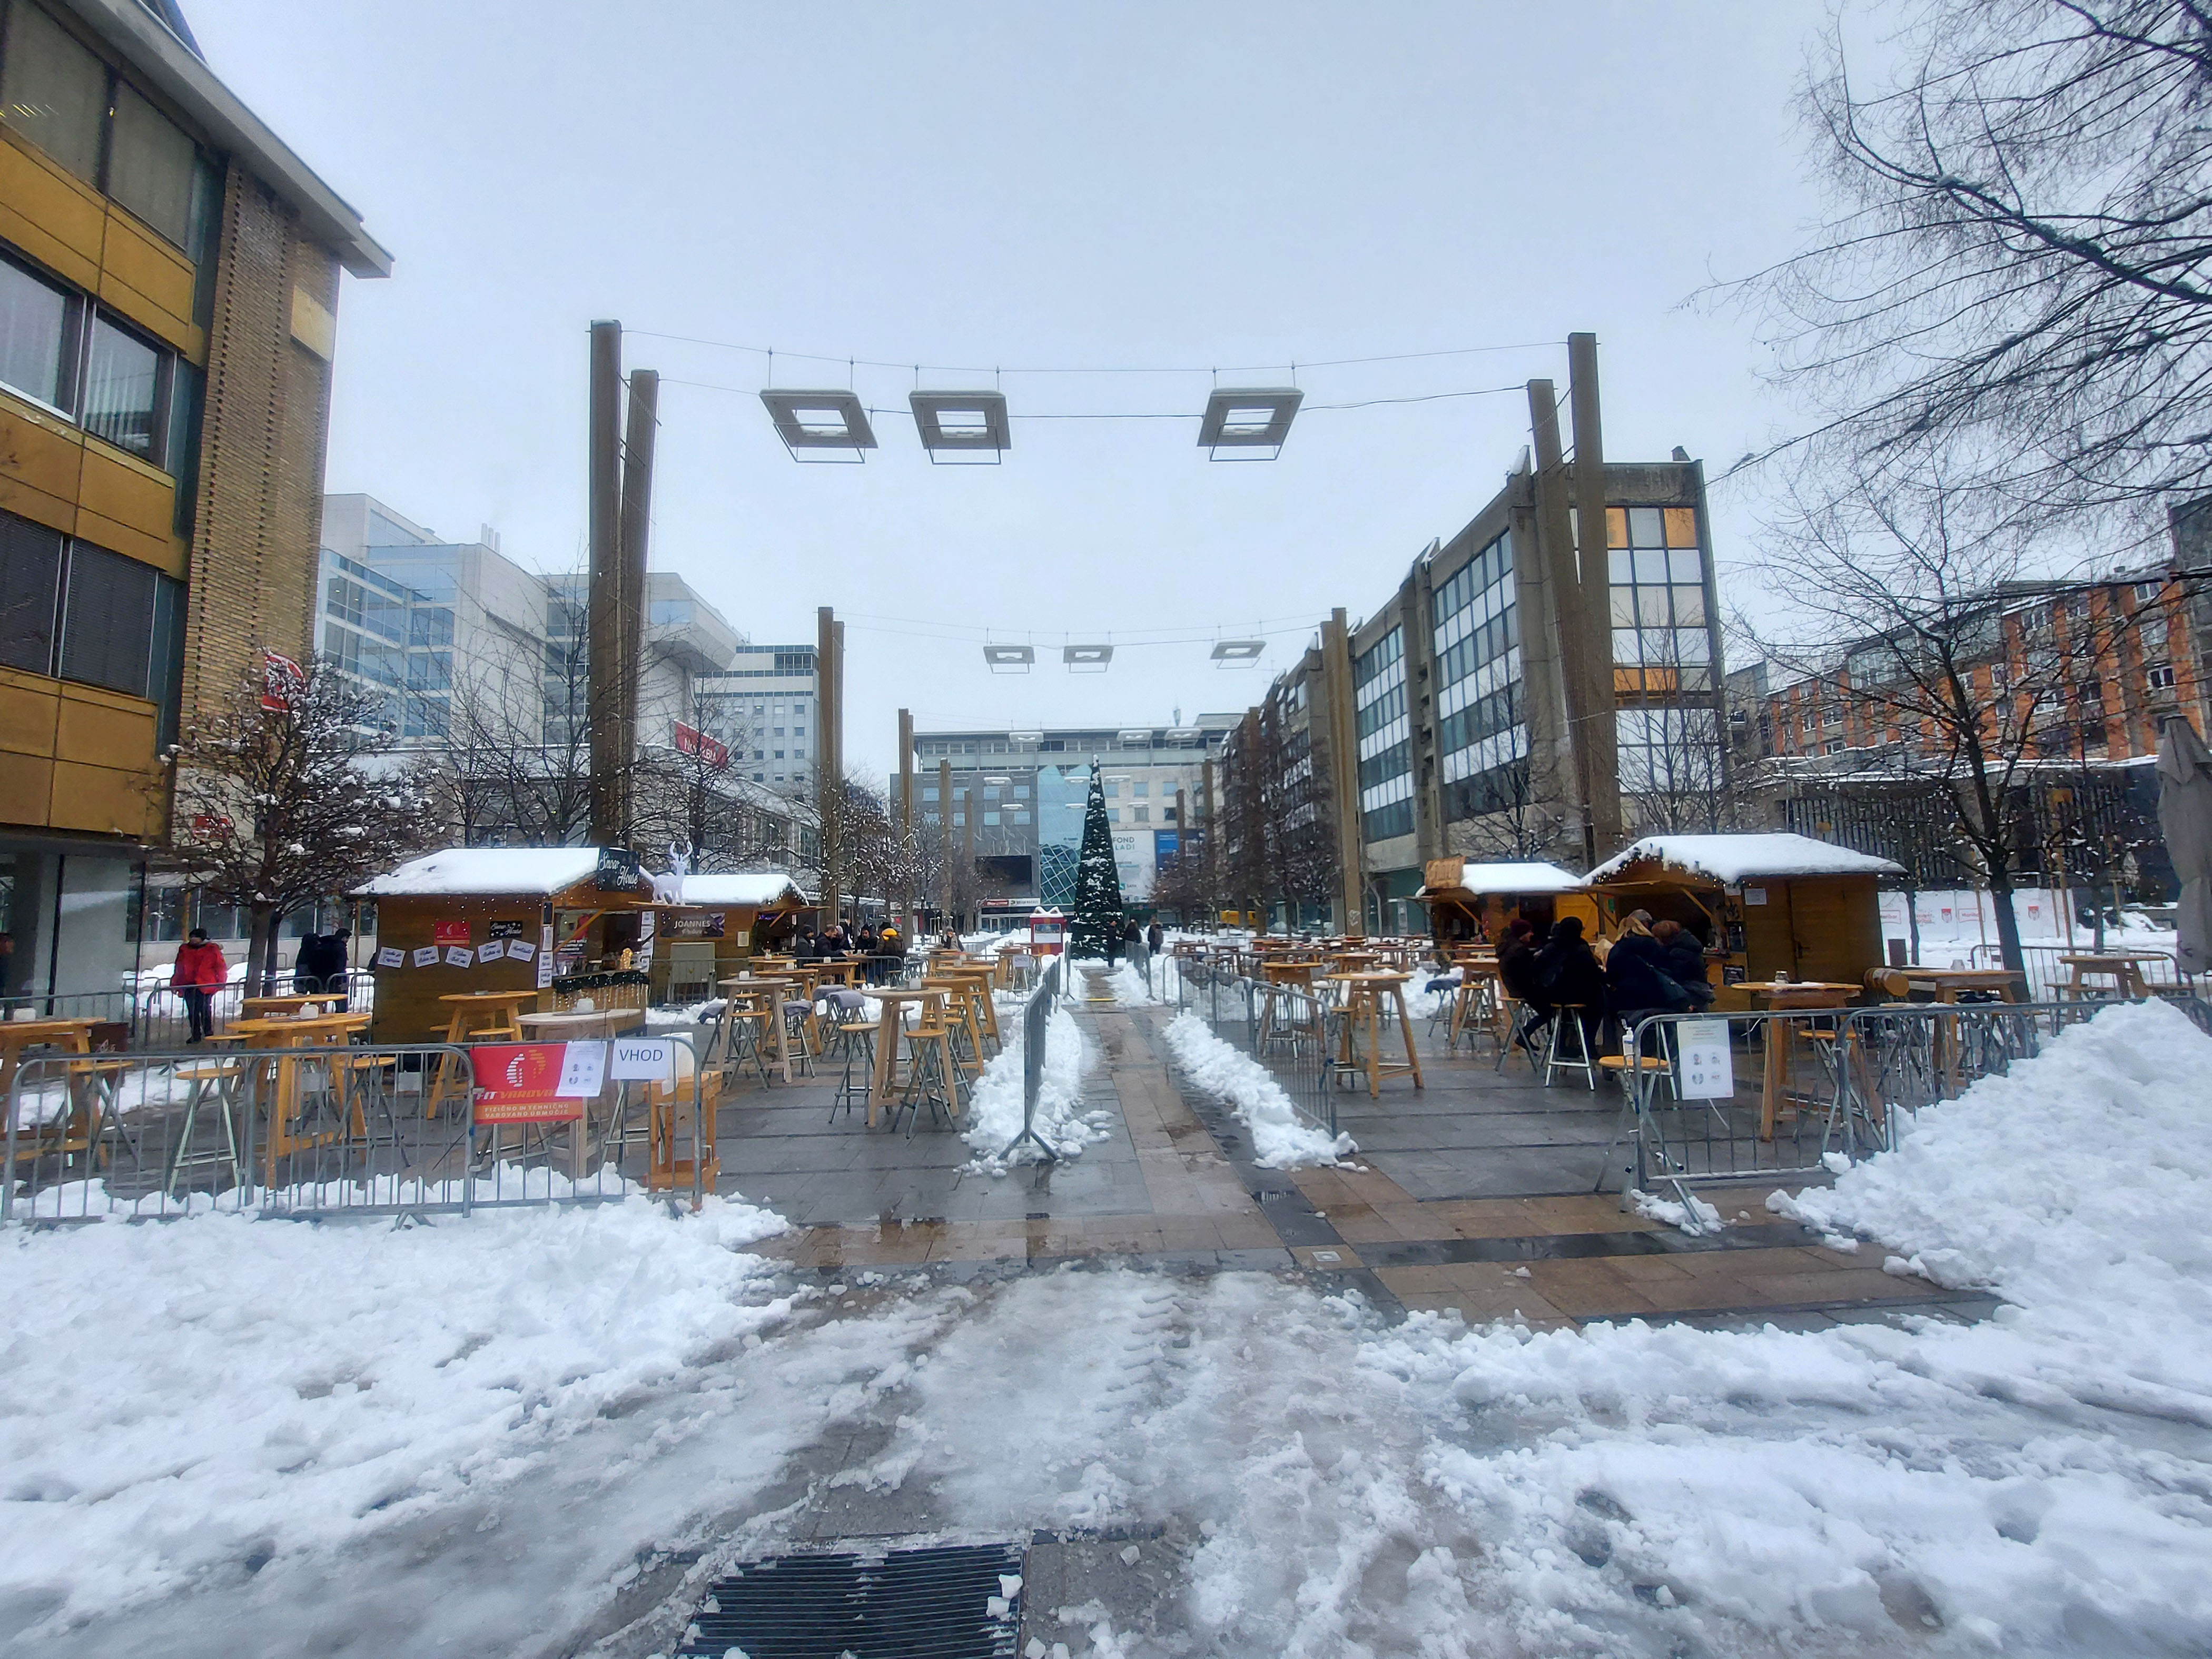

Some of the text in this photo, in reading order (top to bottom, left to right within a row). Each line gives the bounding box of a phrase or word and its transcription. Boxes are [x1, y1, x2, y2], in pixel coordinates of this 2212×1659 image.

[598, 851, 620, 871] Snow
[617, 865, 639, 886] House
[674, 920, 711, 929] JOANNES
[619, 1049, 663, 1062] VHOD
[500, 1089, 557, 1099] VAROVA
